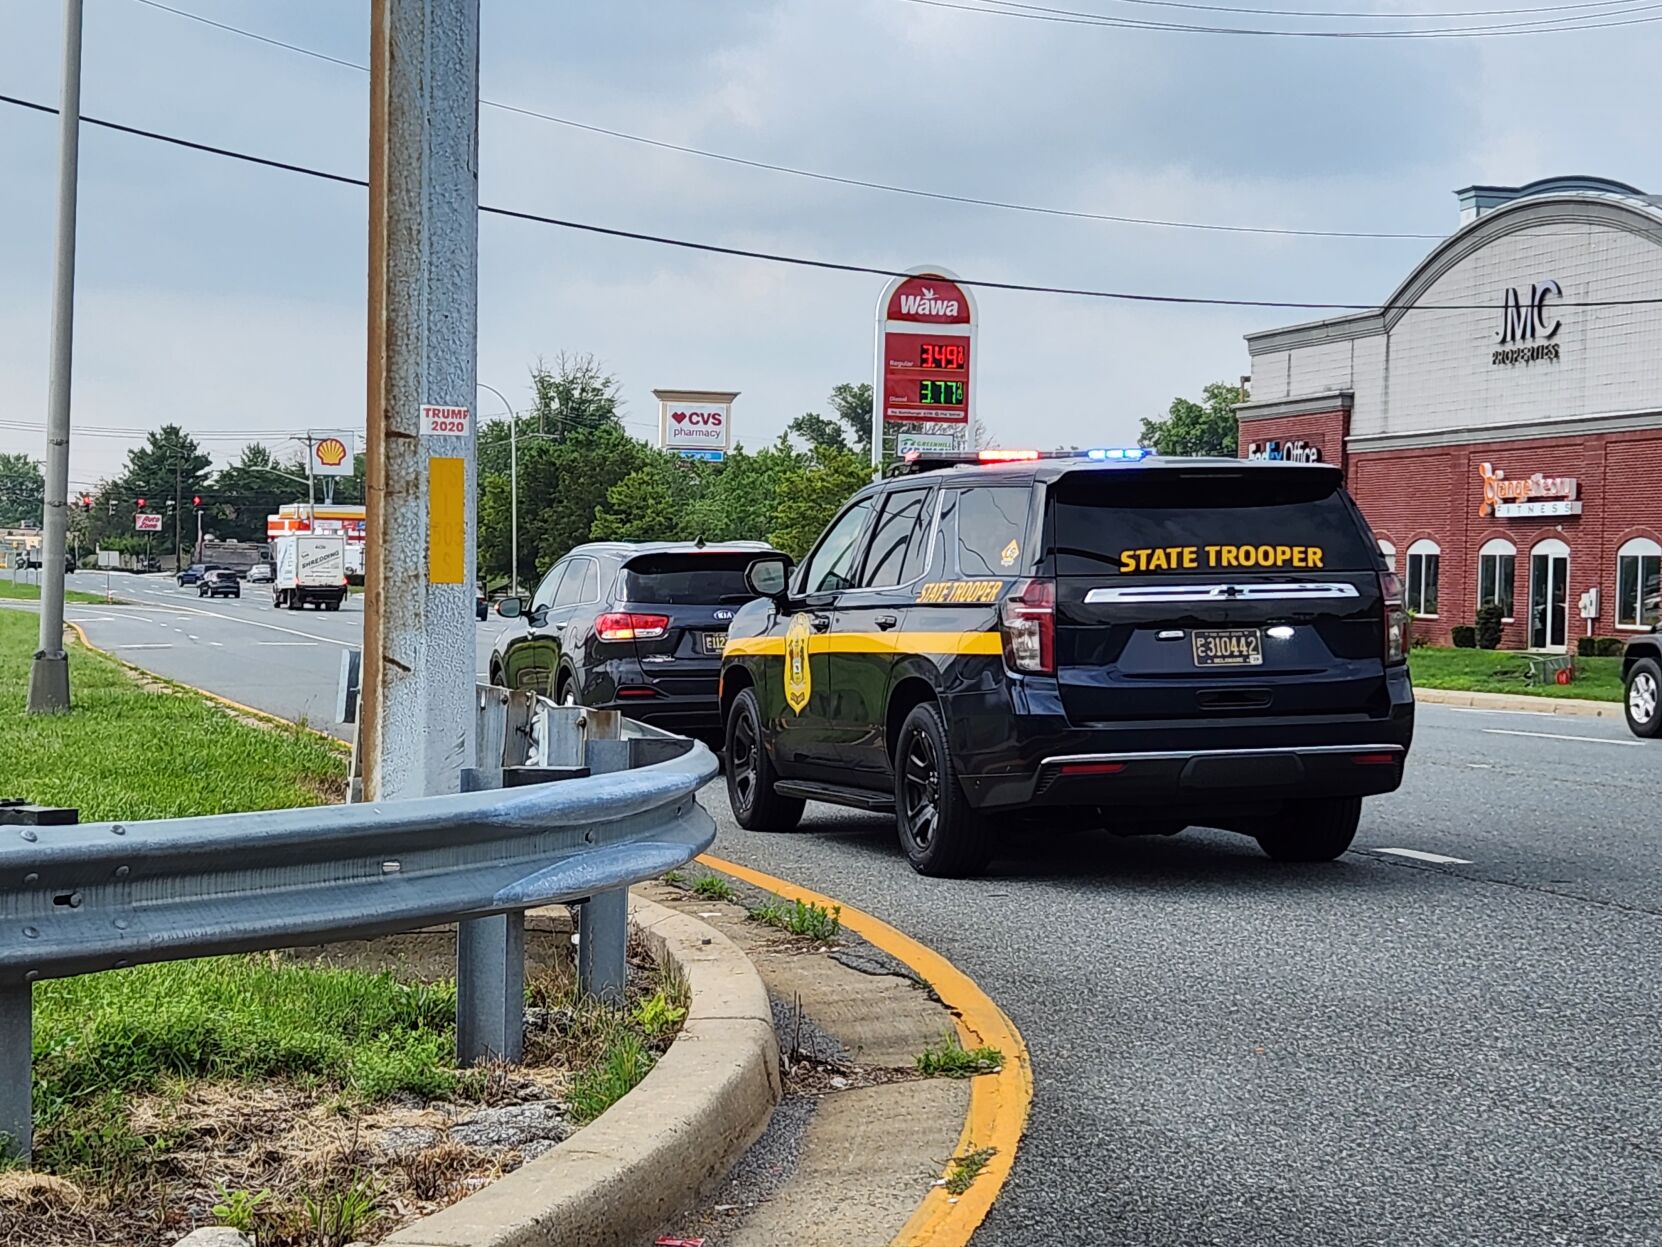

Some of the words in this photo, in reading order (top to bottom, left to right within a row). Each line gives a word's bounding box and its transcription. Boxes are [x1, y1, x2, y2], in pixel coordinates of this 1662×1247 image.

[900, 294, 959, 316] Wawa
[1494, 280, 1563, 344] JMC
[1492, 343, 1560, 366] PROPERTIES
[889, 360, 914, 368] Regular
[423, 407, 469, 420] TRUMP
[688, 412, 722, 426] CVS
[431, 420, 464, 432] 2020
[673, 427, 721, 439] pharmacy
[916, 440, 952, 448] GREENHILL
[1283, 441, 1318, 463] Office
[1497, 503, 1571, 513] FITNESS
[301, 550, 340, 569] SHREDDING
[1119, 546, 1198, 573] STATE
[1204, 545, 1324, 568] TROOPER
[915, 582, 951, 603] STATE
[946, 581, 1003, 602] TROOPER
[717, 611, 732, 619] KIA
[1206, 637, 1258, 656] 310442
